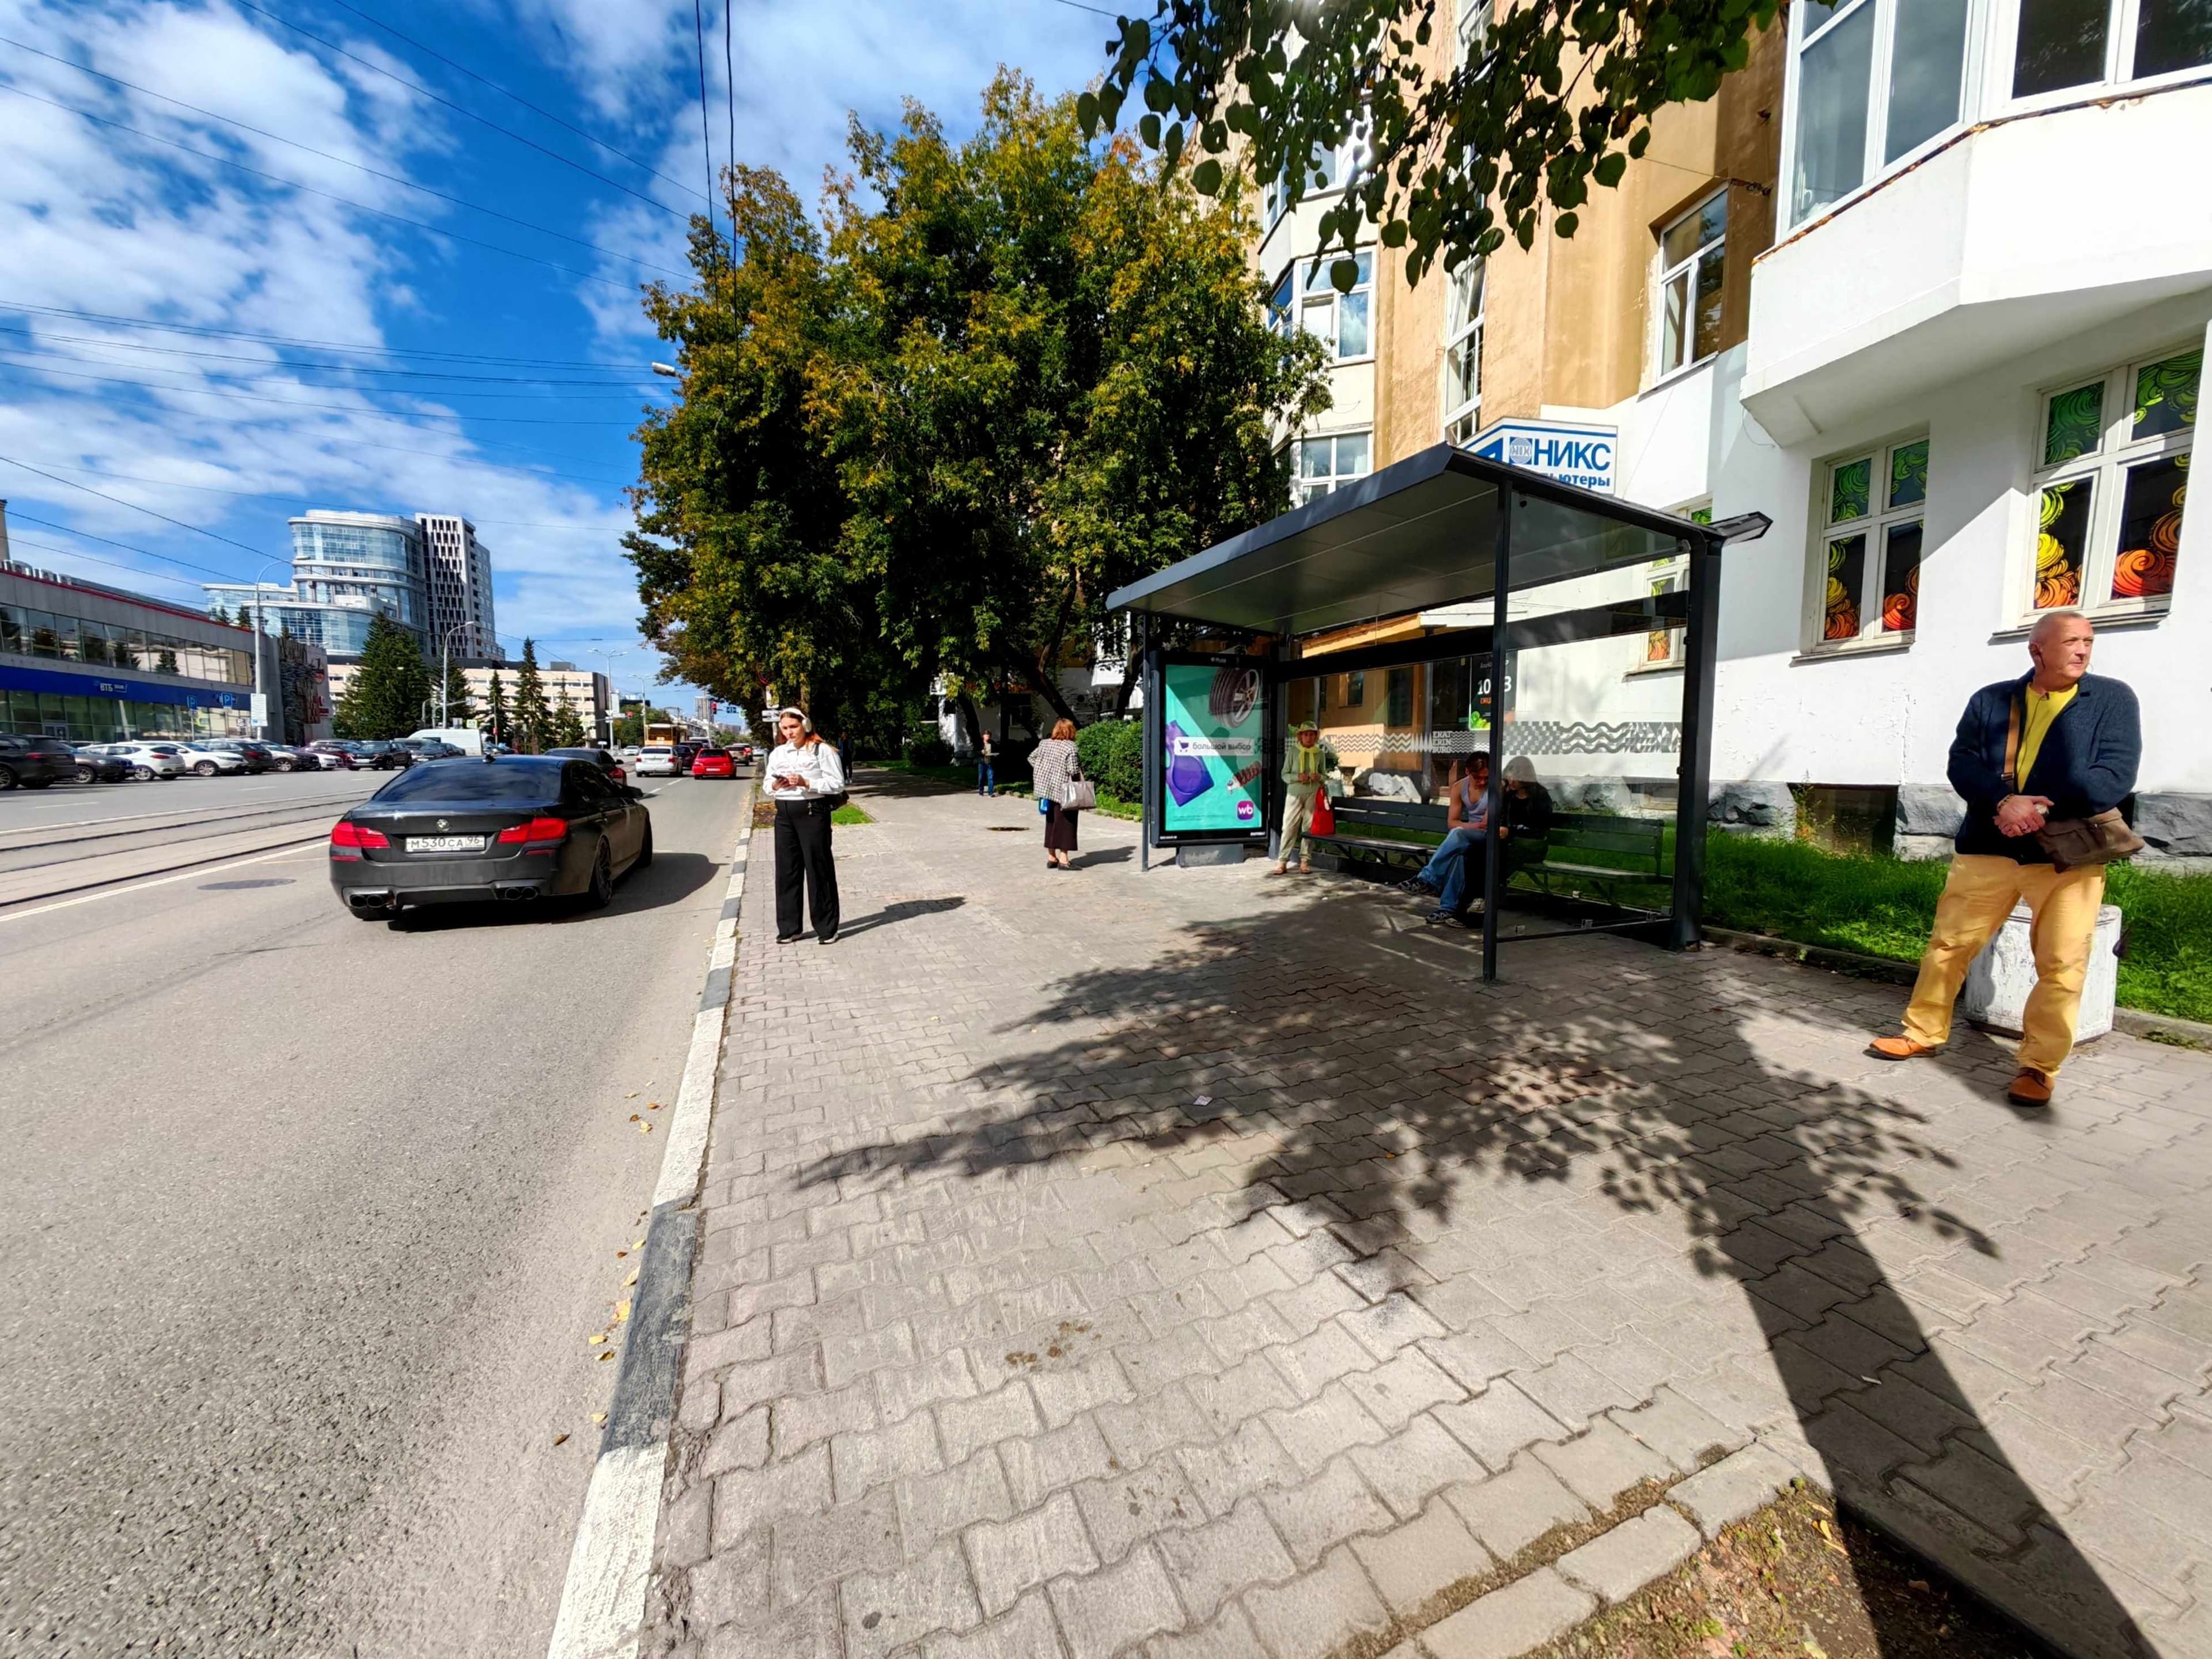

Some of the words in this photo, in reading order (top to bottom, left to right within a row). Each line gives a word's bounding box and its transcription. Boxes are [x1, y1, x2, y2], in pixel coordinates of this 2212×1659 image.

[1533, 438, 1611, 471] НИКС
[1541, 472, 1611, 489] ютеры
[100, 683, 113, 692] ВТБ
[1228, 742, 1251, 751] выбор
[1238, 804, 1253, 815] wb
[467, 836, 480, 844] 96
